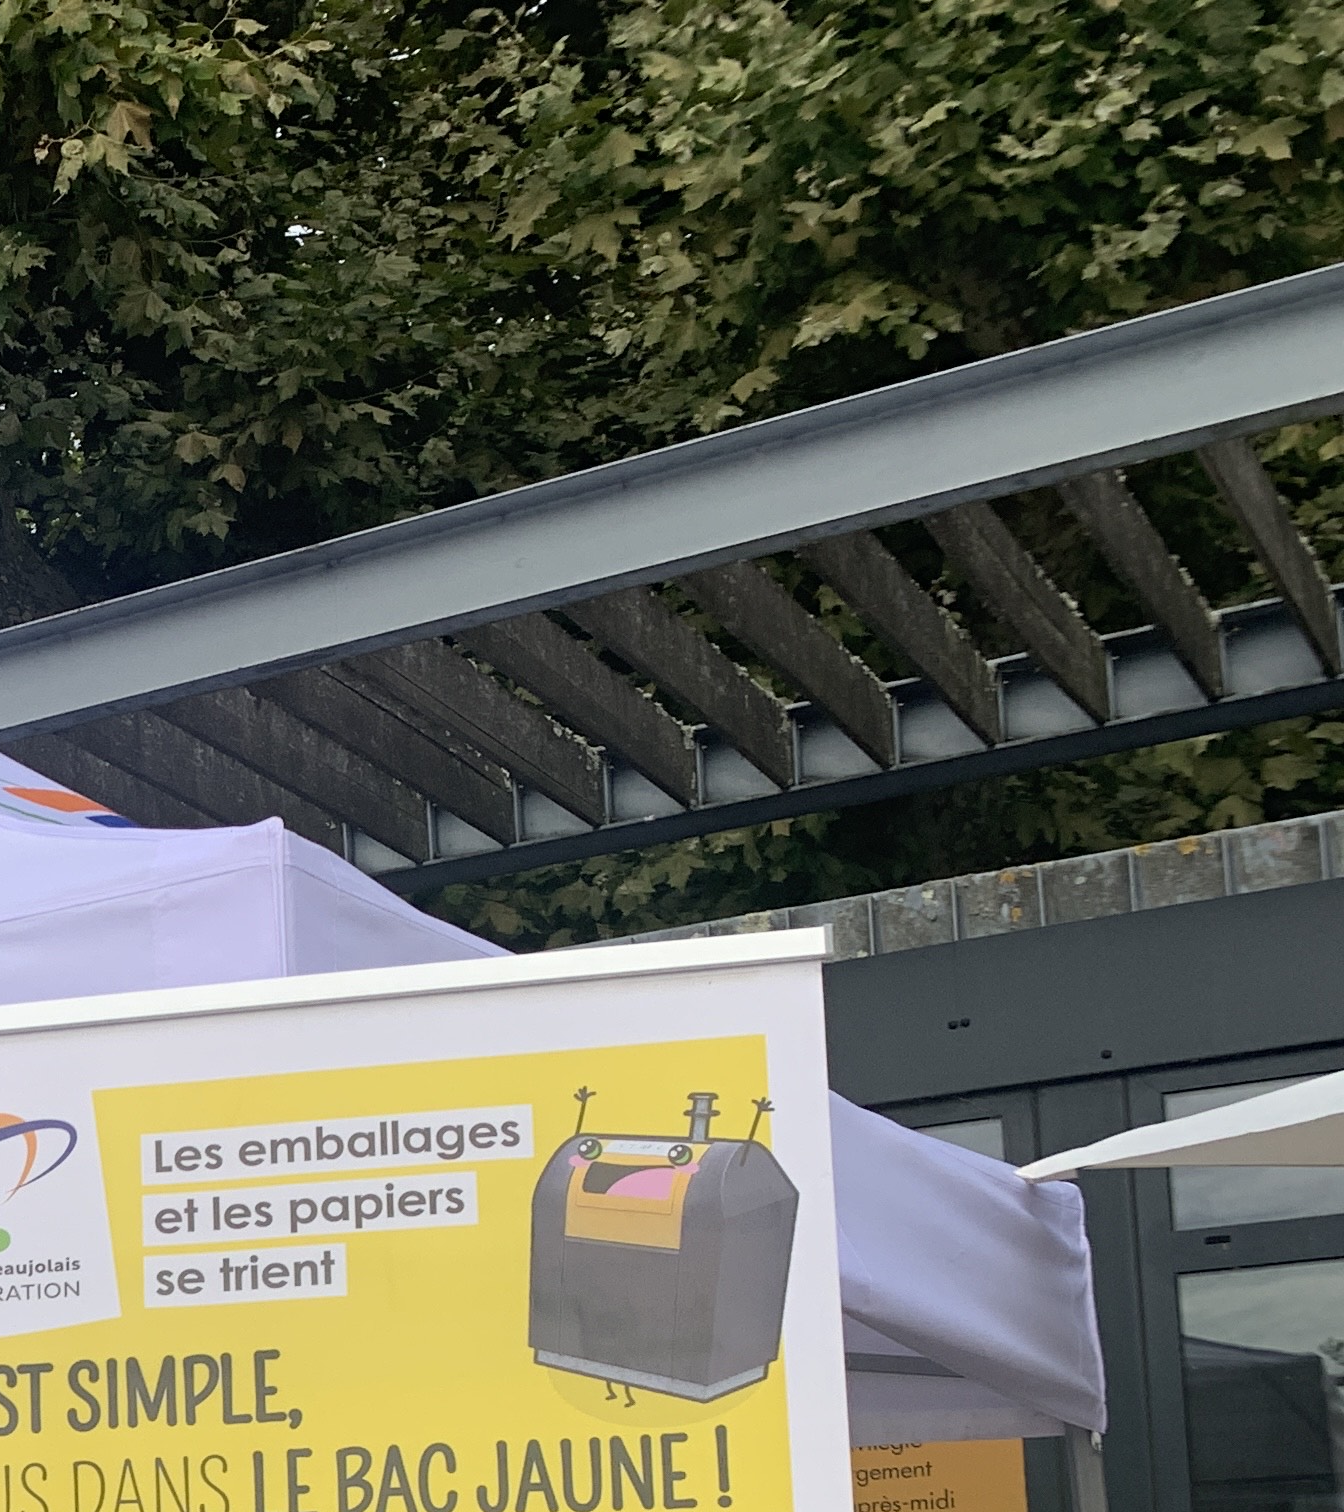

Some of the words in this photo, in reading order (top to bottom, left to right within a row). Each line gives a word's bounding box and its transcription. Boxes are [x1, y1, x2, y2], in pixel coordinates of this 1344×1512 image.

[155, 1140, 222, 1172] Les
[239, 1121, 520, 1166] emballages
[155, 1199, 198, 1234] et
[213, 1197, 273, 1230] les
[290, 1183, 464, 1233] papiers
[157, 1269, 205, 1295] se
[220, 1251, 335, 1291] trient
[67, 1349, 302, 1432] SIMPLE,
[715, 1425, 732, 1508] !
[853, 1461, 933, 1487] gement
